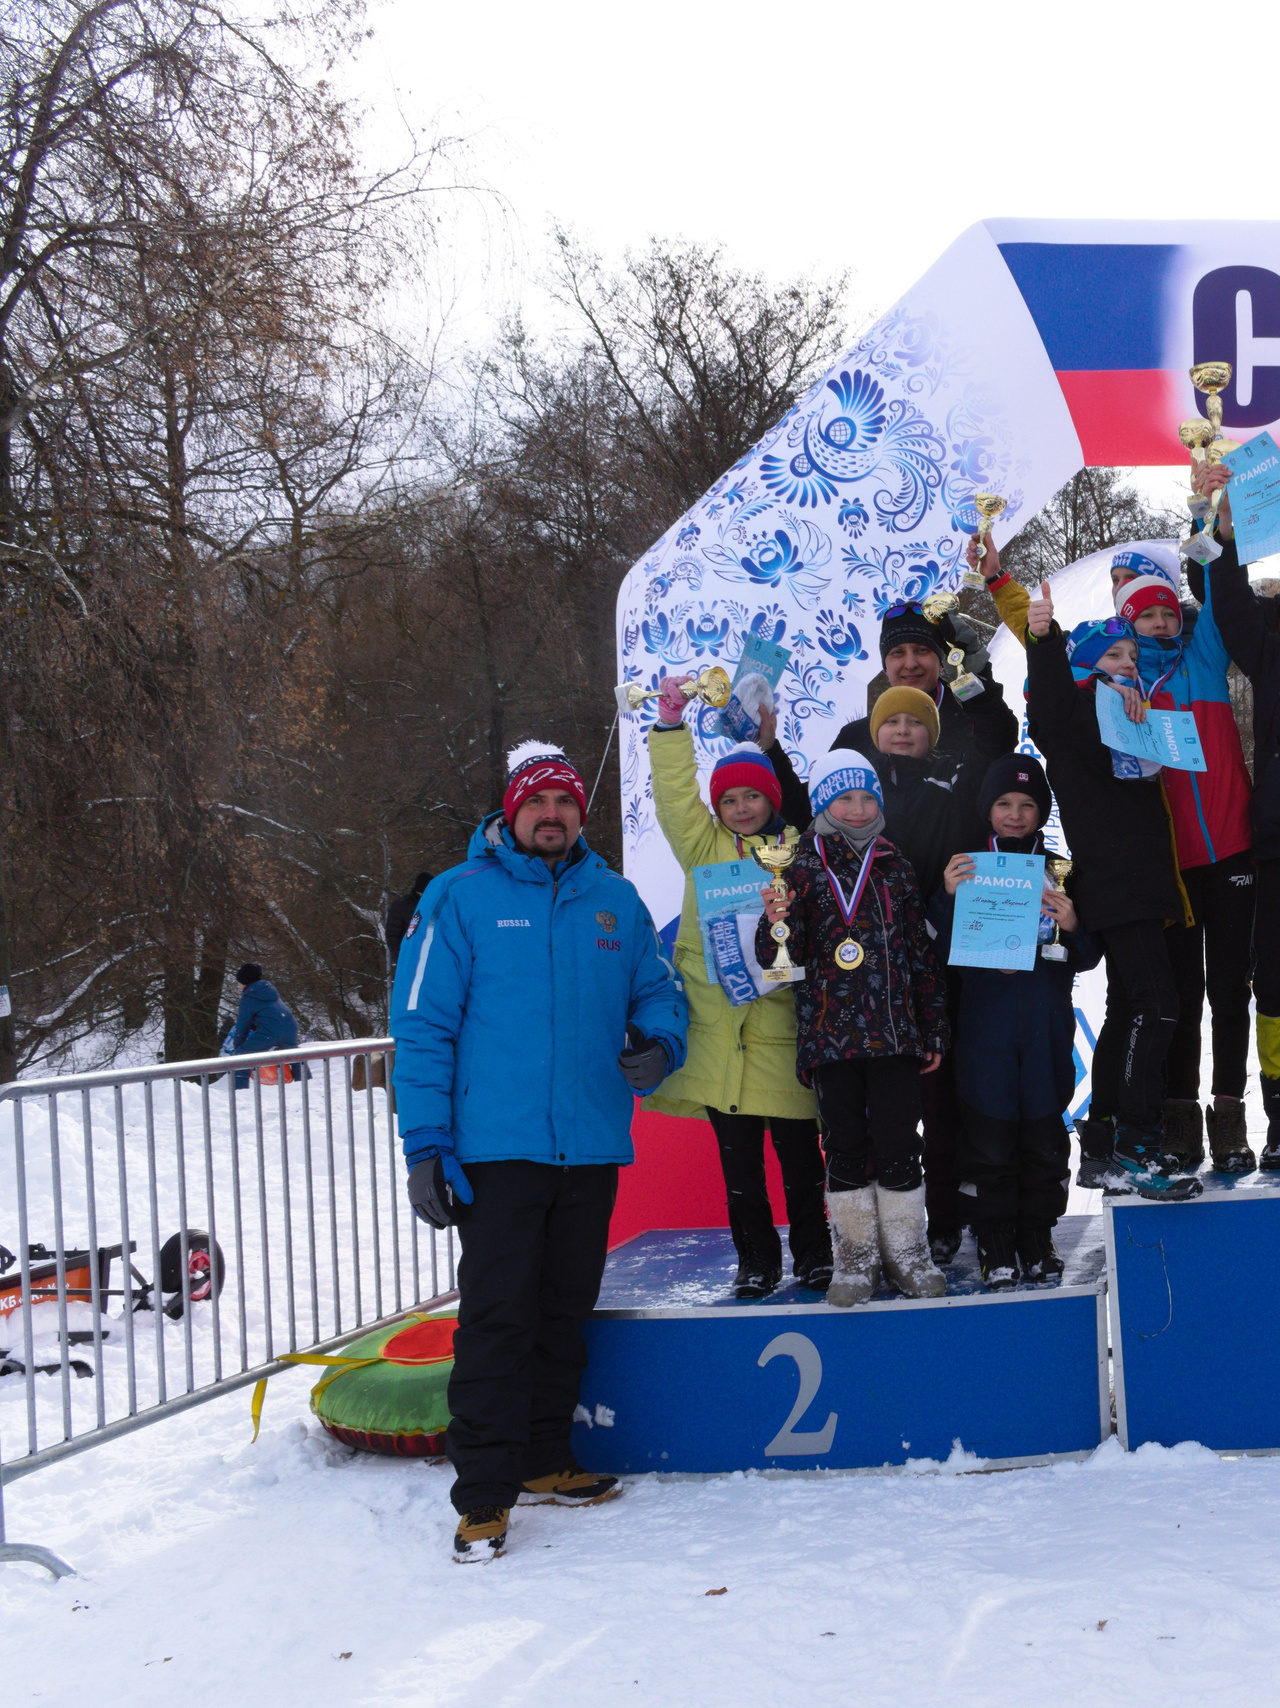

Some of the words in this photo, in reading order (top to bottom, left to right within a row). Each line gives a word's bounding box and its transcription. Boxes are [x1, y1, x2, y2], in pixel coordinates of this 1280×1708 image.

[1233, 456, 1279, 486] ГРАМОТА
[1161, 716, 1181, 762] ГРАМОТА
[704, 881, 771, 899] ГРАМОТА
[497, 919, 531, 928] RUSSIA
[596, 938, 621, 951] RUS
[723, 920, 741, 965] ЛЫЖНЯ
[1124, 1027, 1139, 1087] FISCHER
[758, 1331, 838, 1457] 2
